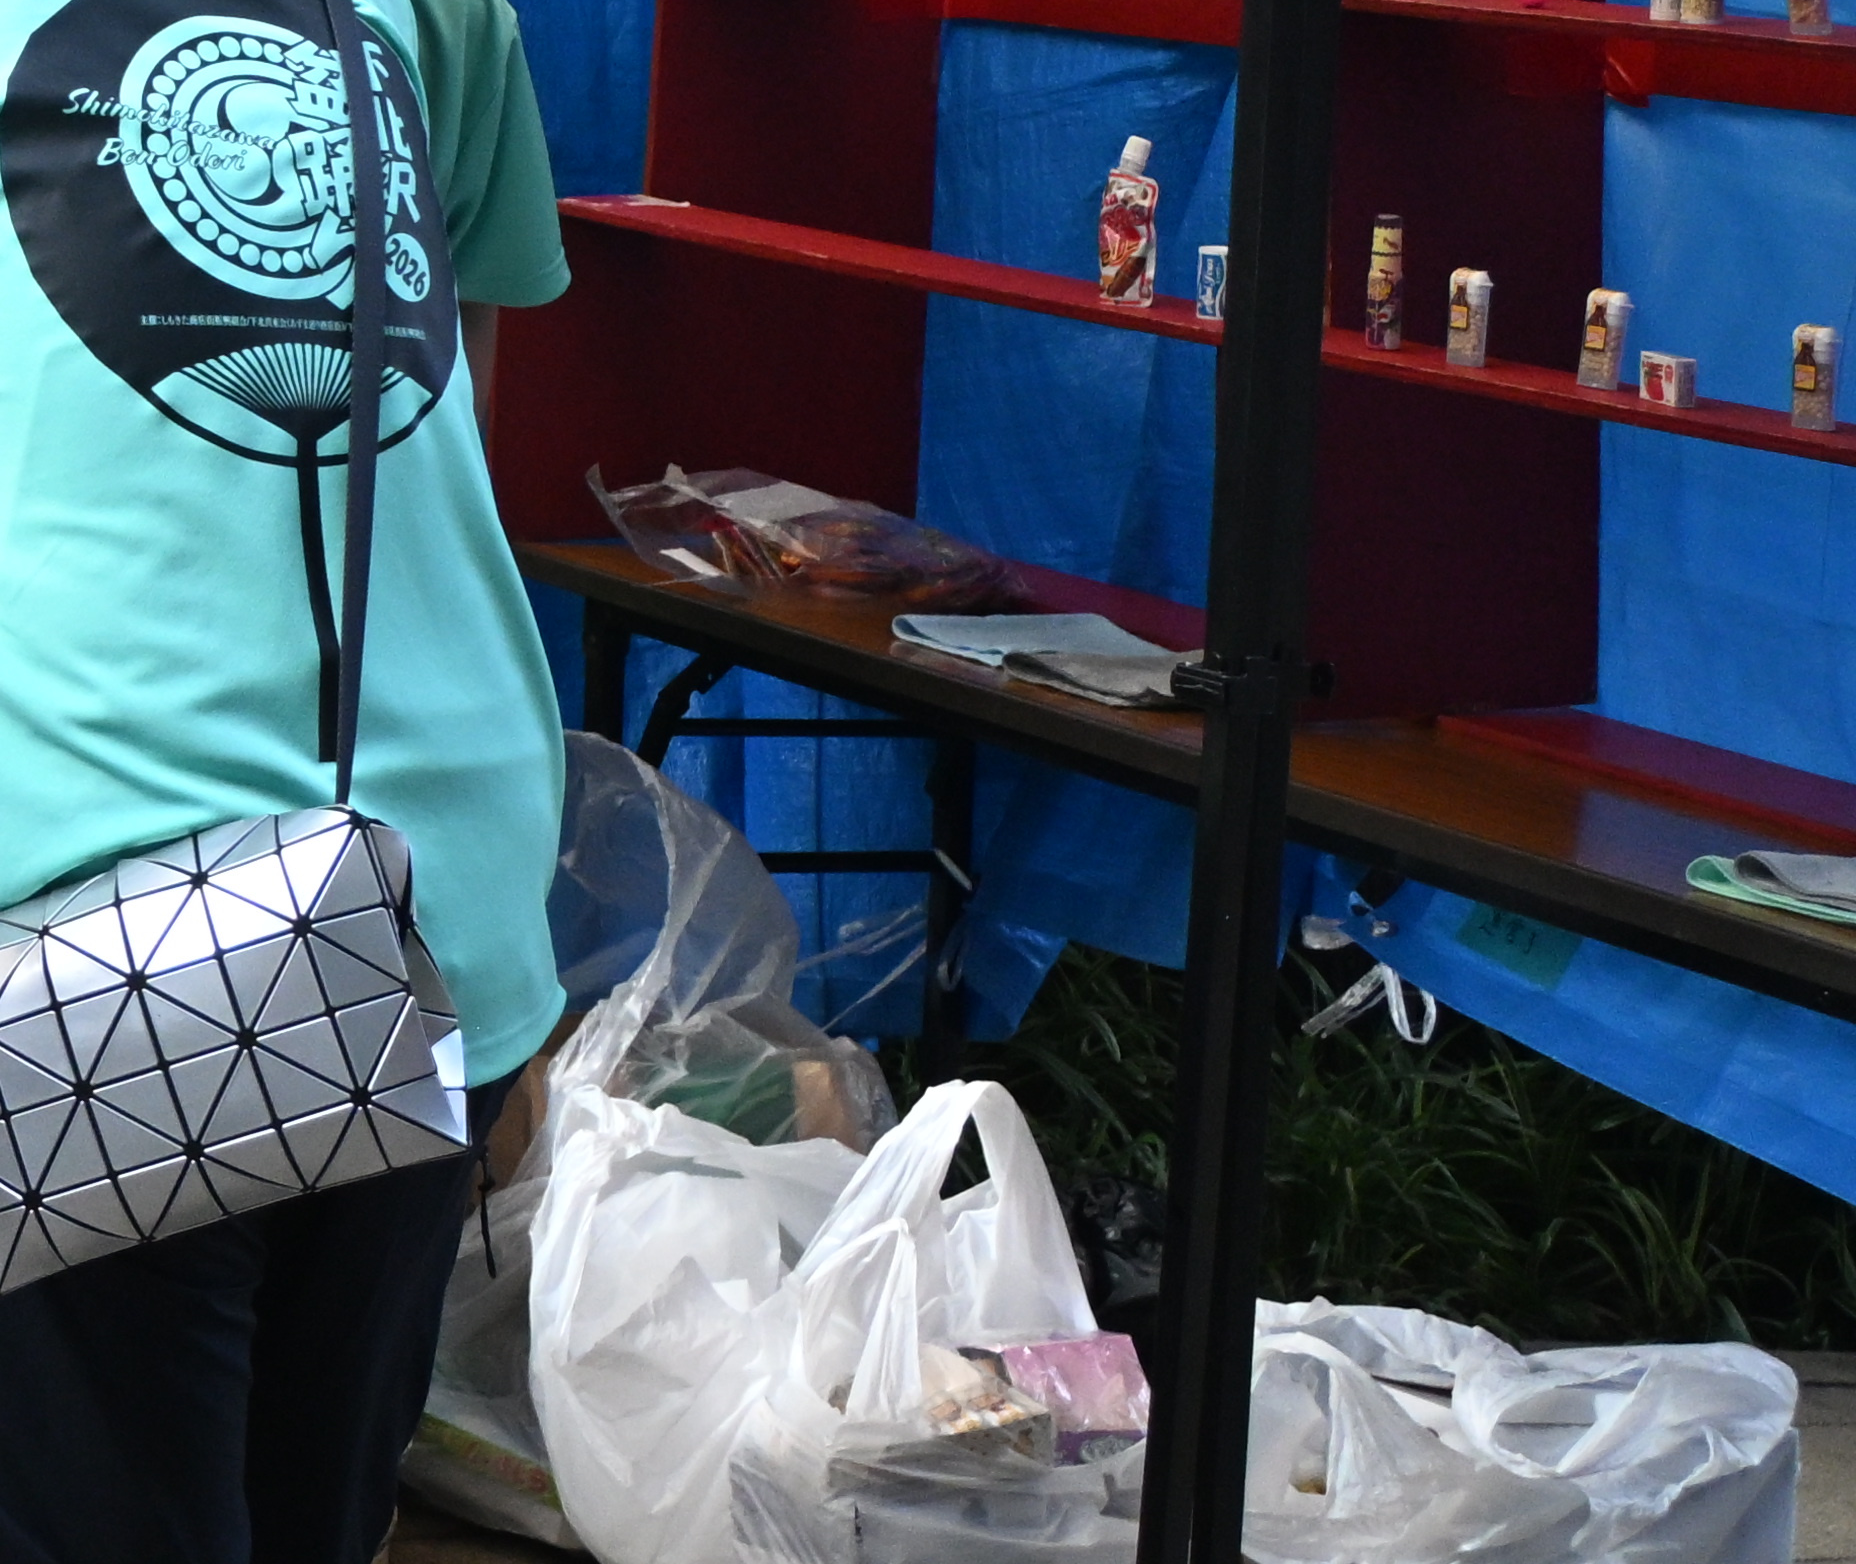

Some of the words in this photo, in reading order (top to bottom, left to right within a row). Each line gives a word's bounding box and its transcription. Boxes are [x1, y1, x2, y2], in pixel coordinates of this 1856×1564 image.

[62, 87, 277, 150] Shimokitazawa
[96, 137, 157, 167] Bon
[166, 139, 248, 171] Odori
[386, 237, 426, 298] 2026
